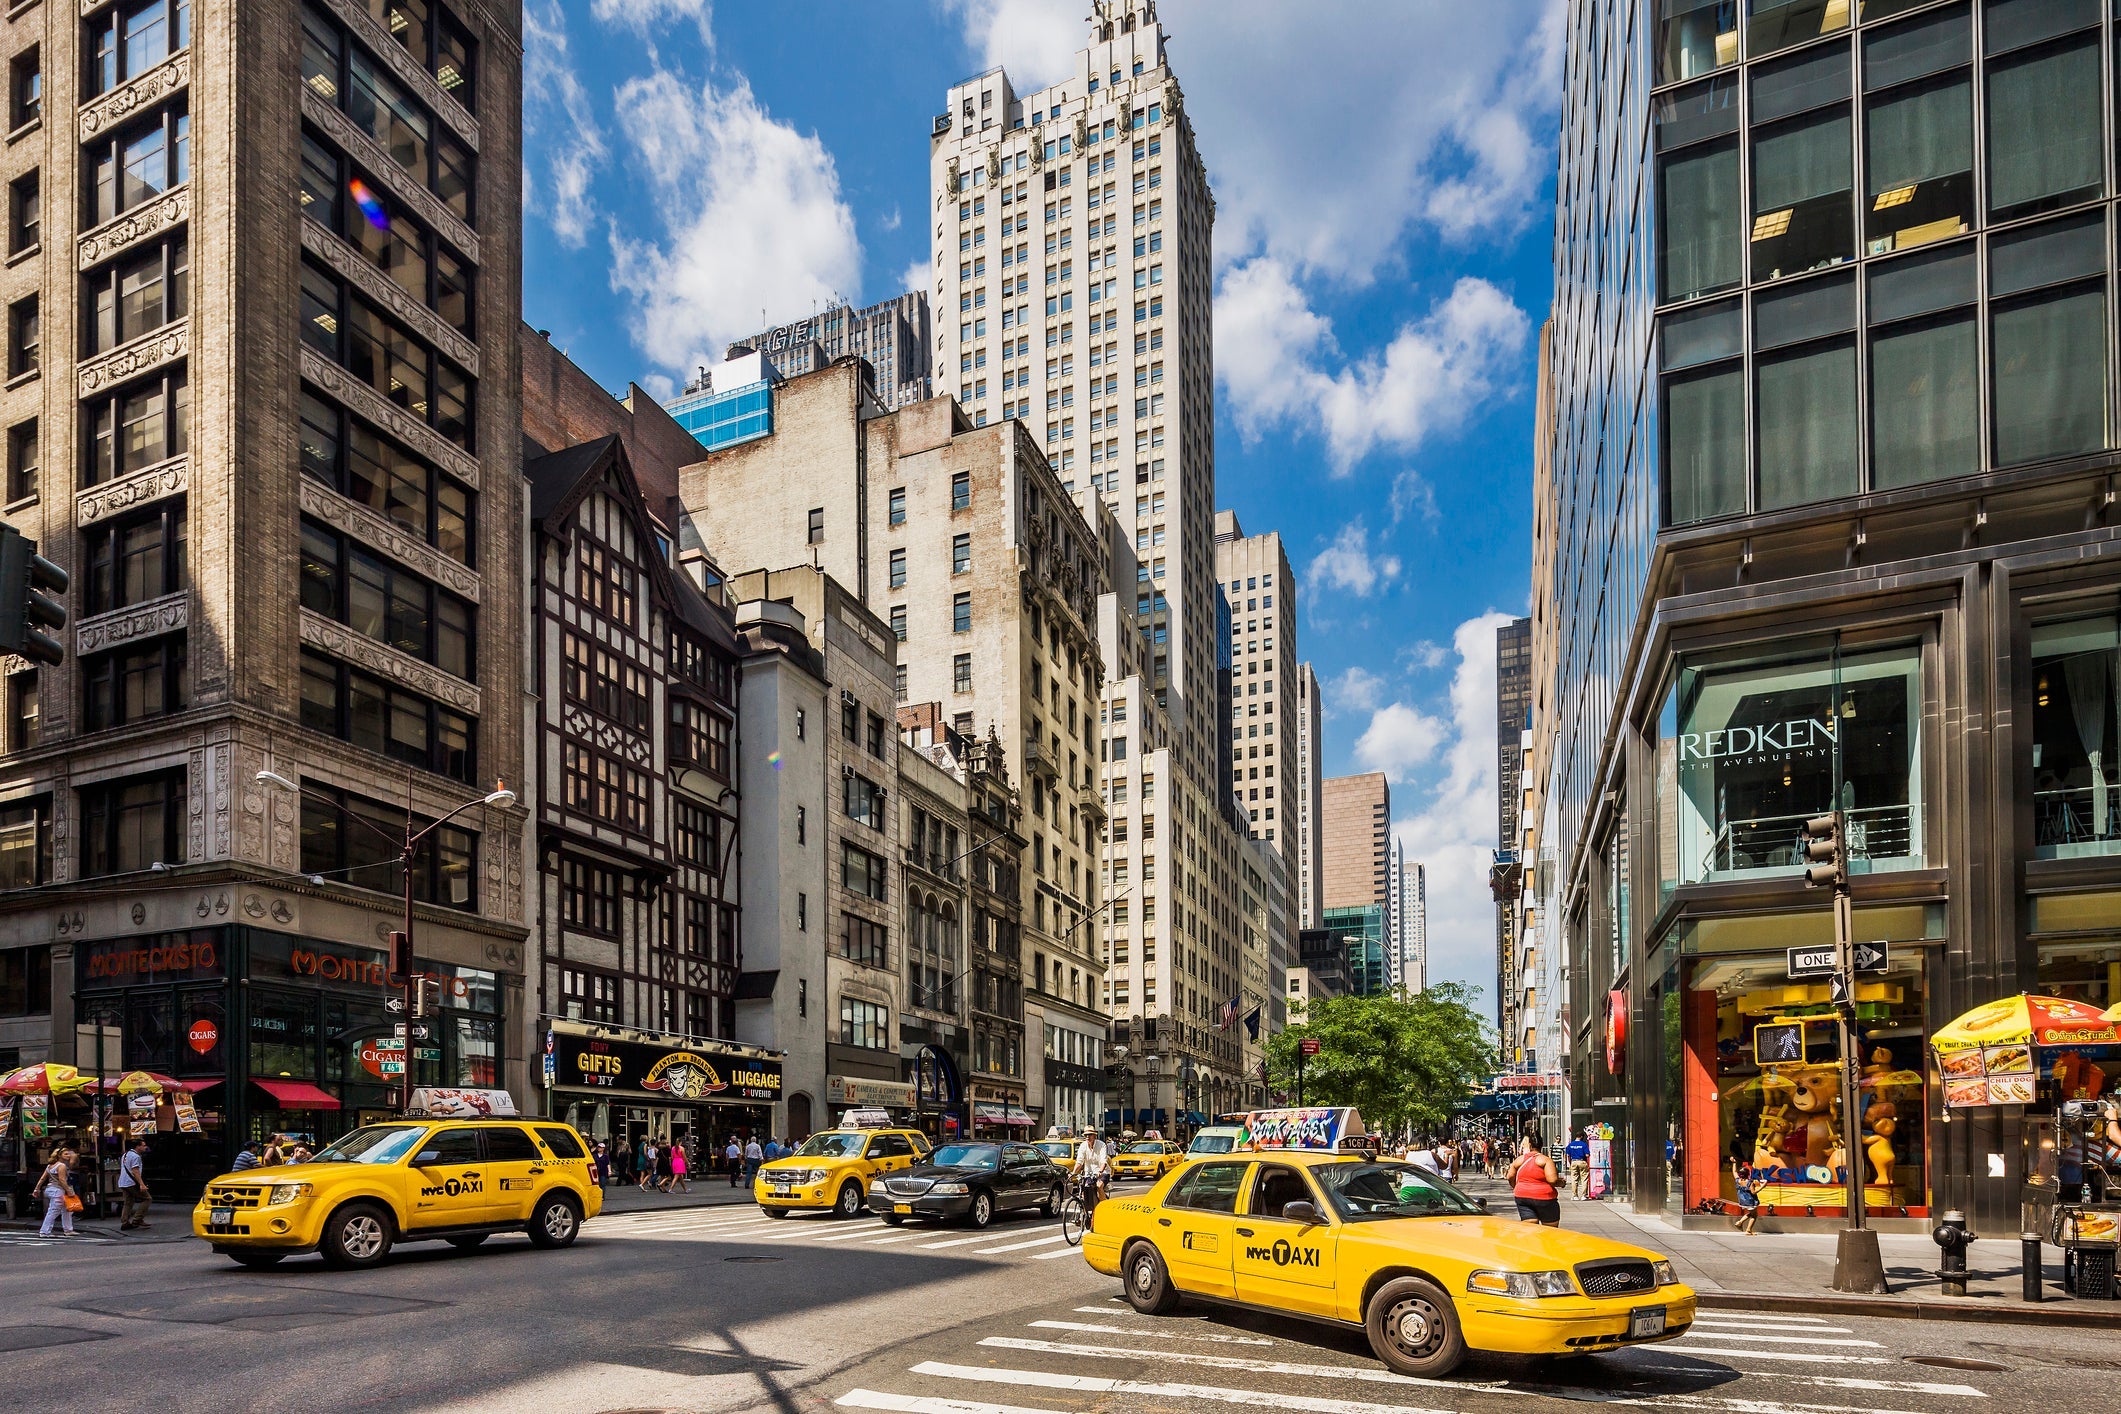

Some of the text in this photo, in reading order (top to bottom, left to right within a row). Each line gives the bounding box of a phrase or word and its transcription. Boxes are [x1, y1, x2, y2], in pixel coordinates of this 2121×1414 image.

[1679, 715, 1838, 761] REDKEN
[1679, 747, 1839, 772] 5TH AVENUE NYC
[89, 942, 216, 977] MONTECRISTO
[1803, 951, 1873, 966] ONE AY
[189, 1030, 217, 1040] CIGARS
[2046, 1026, 2117, 1042] Onion Crunch
[423, 1050, 429, 1058] 5
[387, 1063, 395, 1072] 46
[578, 1053, 622, 1075] GIFTS
[651, 1053, 680, 1077] PHANTOM
[690, 1055, 718, 1081] BROADWAY
[598, 1075, 615, 1086] NY
[732, 1070, 781, 1089] LUGGAGE
[831, 1079, 841, 1088] 47
[1501, 1076, 1545, 1087] GUESS
[845, 1084, 857, 1098] 47
[905, 1089, 916, 1102] 47
[1293, 1111, 1307, 1119] BEST
[1249, 1118, 1287, 1144] ROCK
[1288, 1112, 1336, 1145] AGES
[1348, 1138, 1365, 1148] 1C67
[421, 1178, 484, 1197] NYC TAXI
[1246, 1238, 1320, 1268] NYC TAXI
